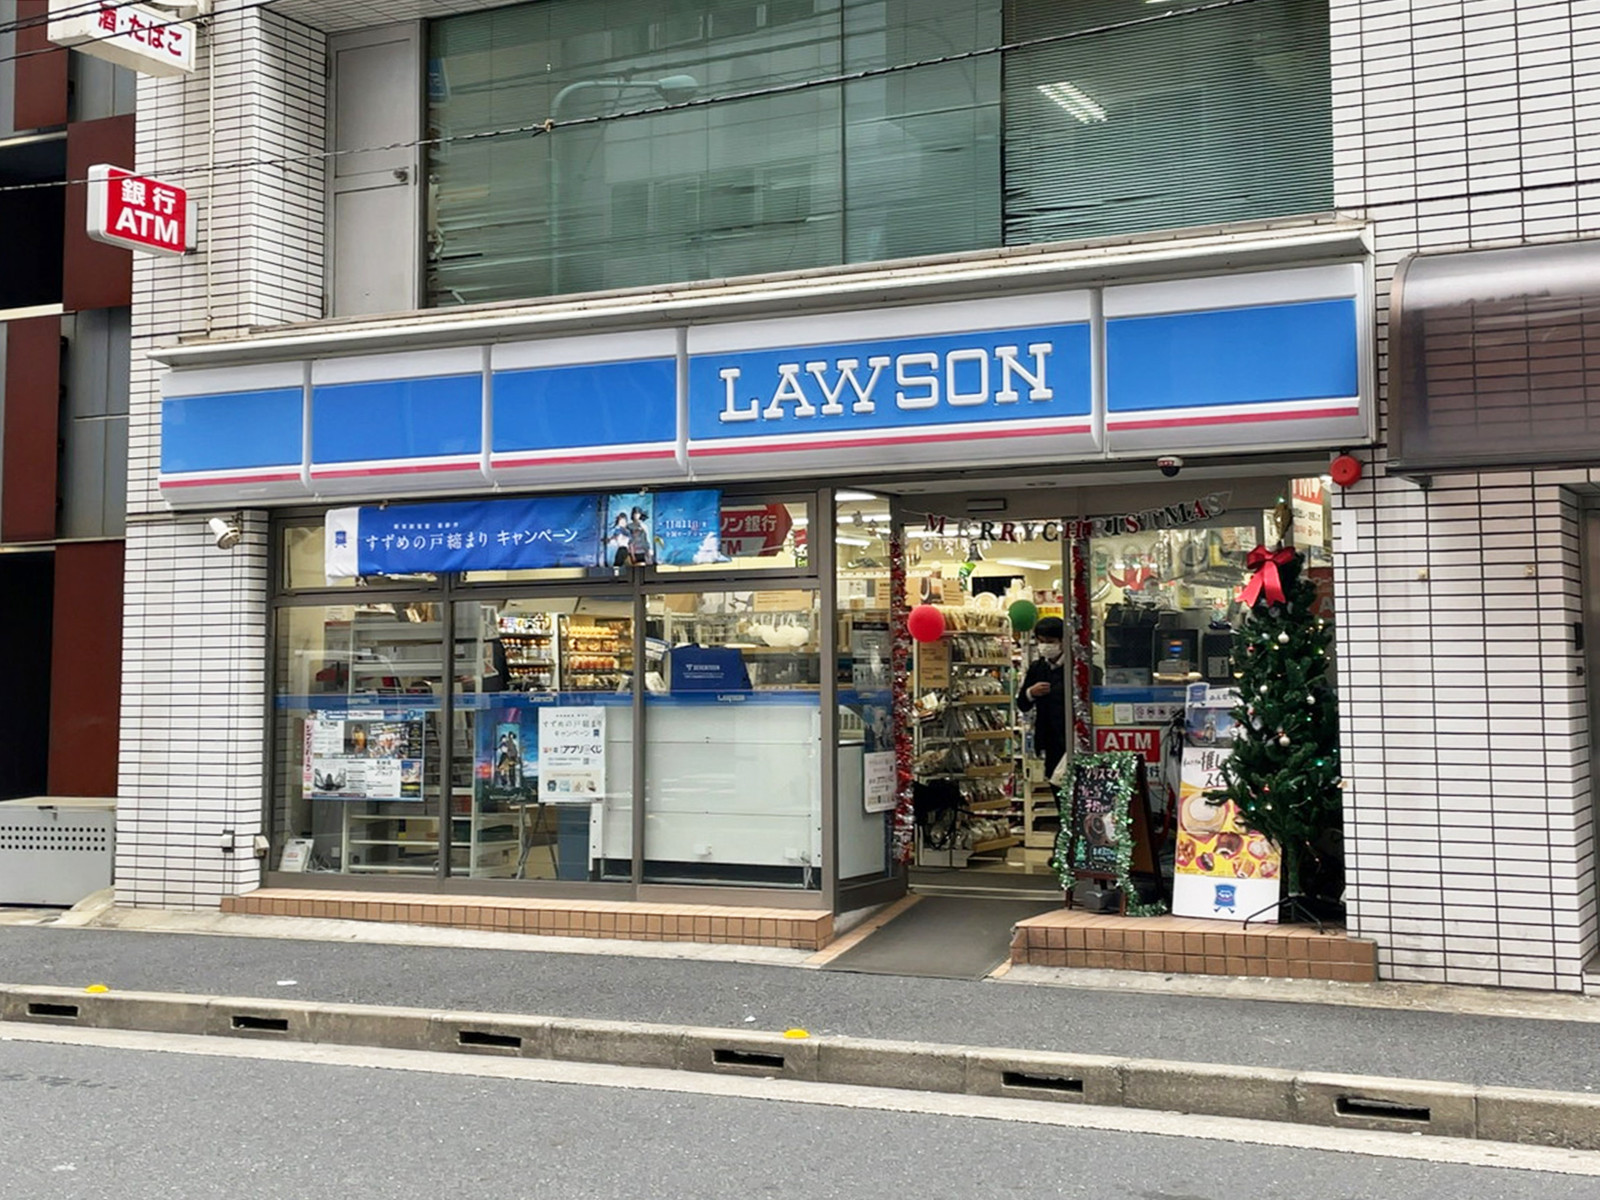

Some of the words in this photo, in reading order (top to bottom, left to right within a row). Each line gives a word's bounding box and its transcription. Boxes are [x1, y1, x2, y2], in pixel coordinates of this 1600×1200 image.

[121, 178, 176, 215] 銀行
[115, 206, 179, 245] ATM
[719, 342, 1054, 423] LAWSON
[366, 532, 488, 551] すずめの戸締まり
[497, 528, 578, 547] キャンペーン
[1104, 732, 1152, 750] ATM
